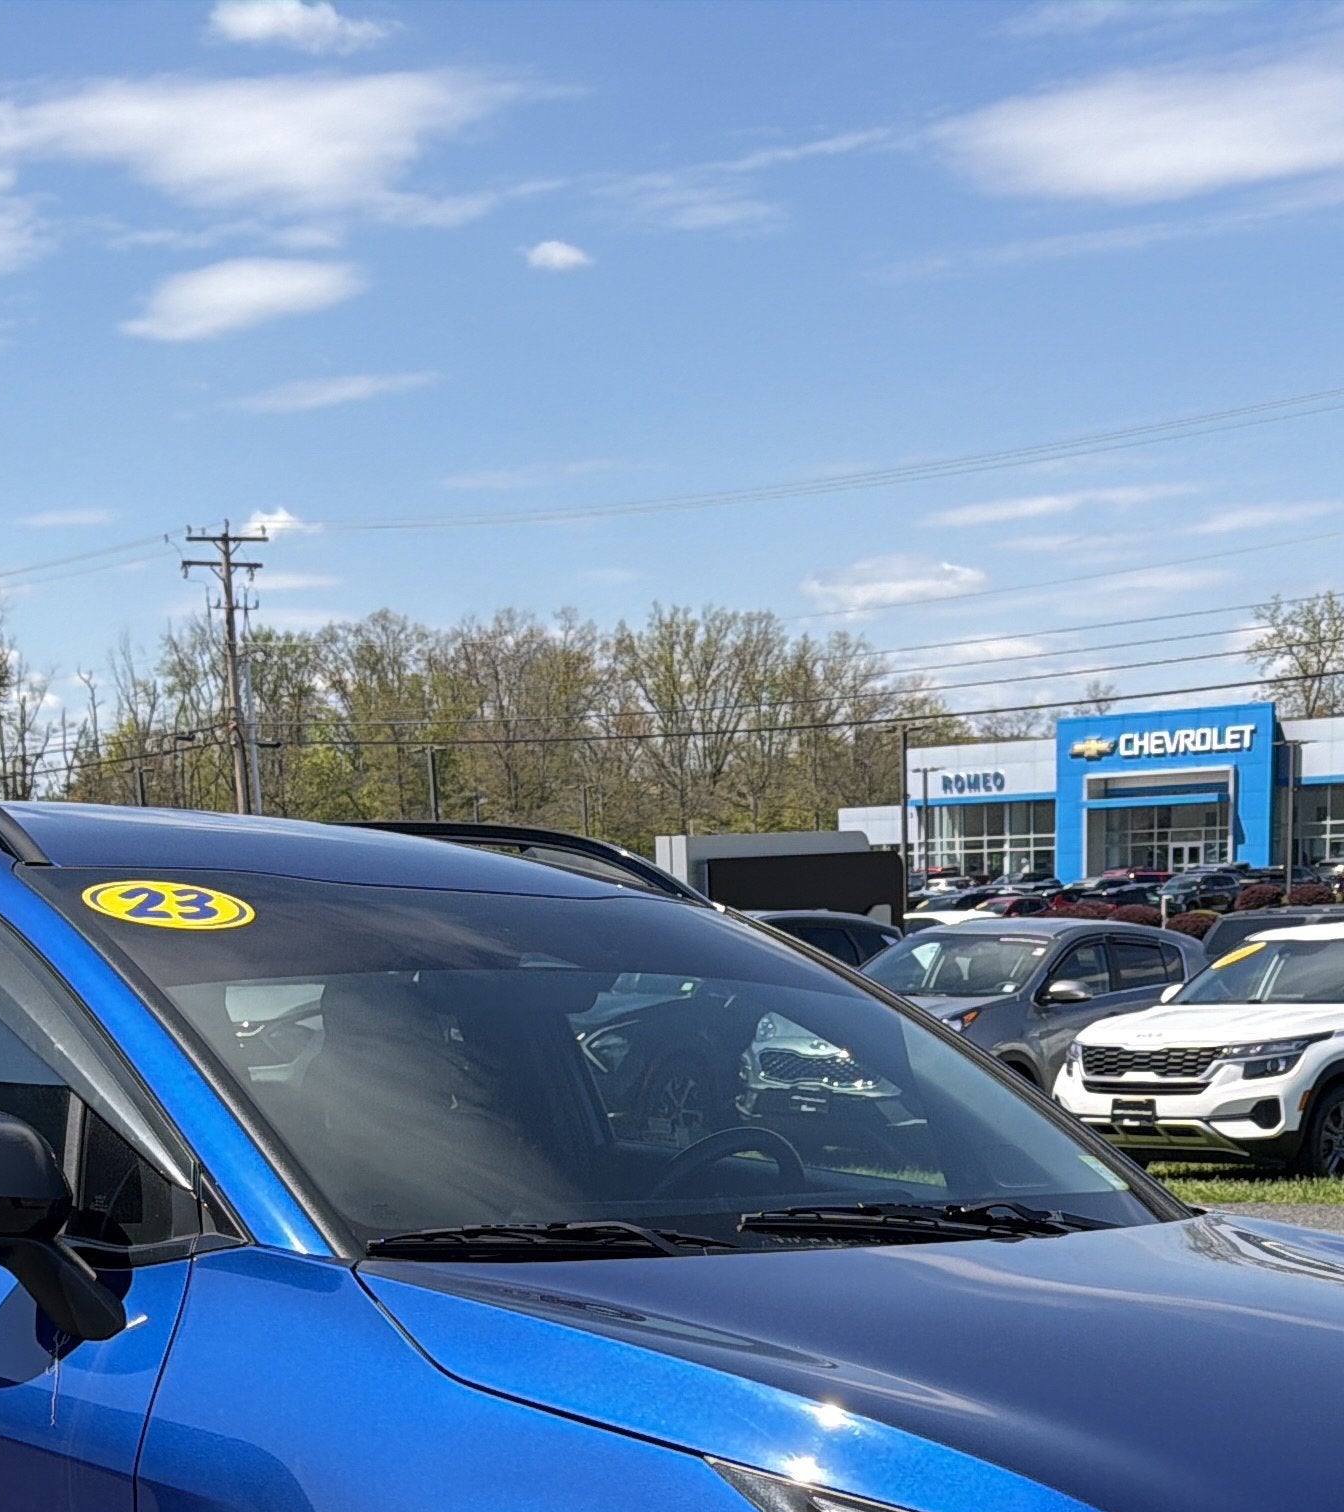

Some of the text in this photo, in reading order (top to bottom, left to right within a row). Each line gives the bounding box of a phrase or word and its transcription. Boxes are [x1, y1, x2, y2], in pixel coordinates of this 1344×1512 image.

[1119, 724, 1256, 759] CHEVROLET
[941, 770, 1006, 795] ROMEO
[118, 887, 219, 920] 23
